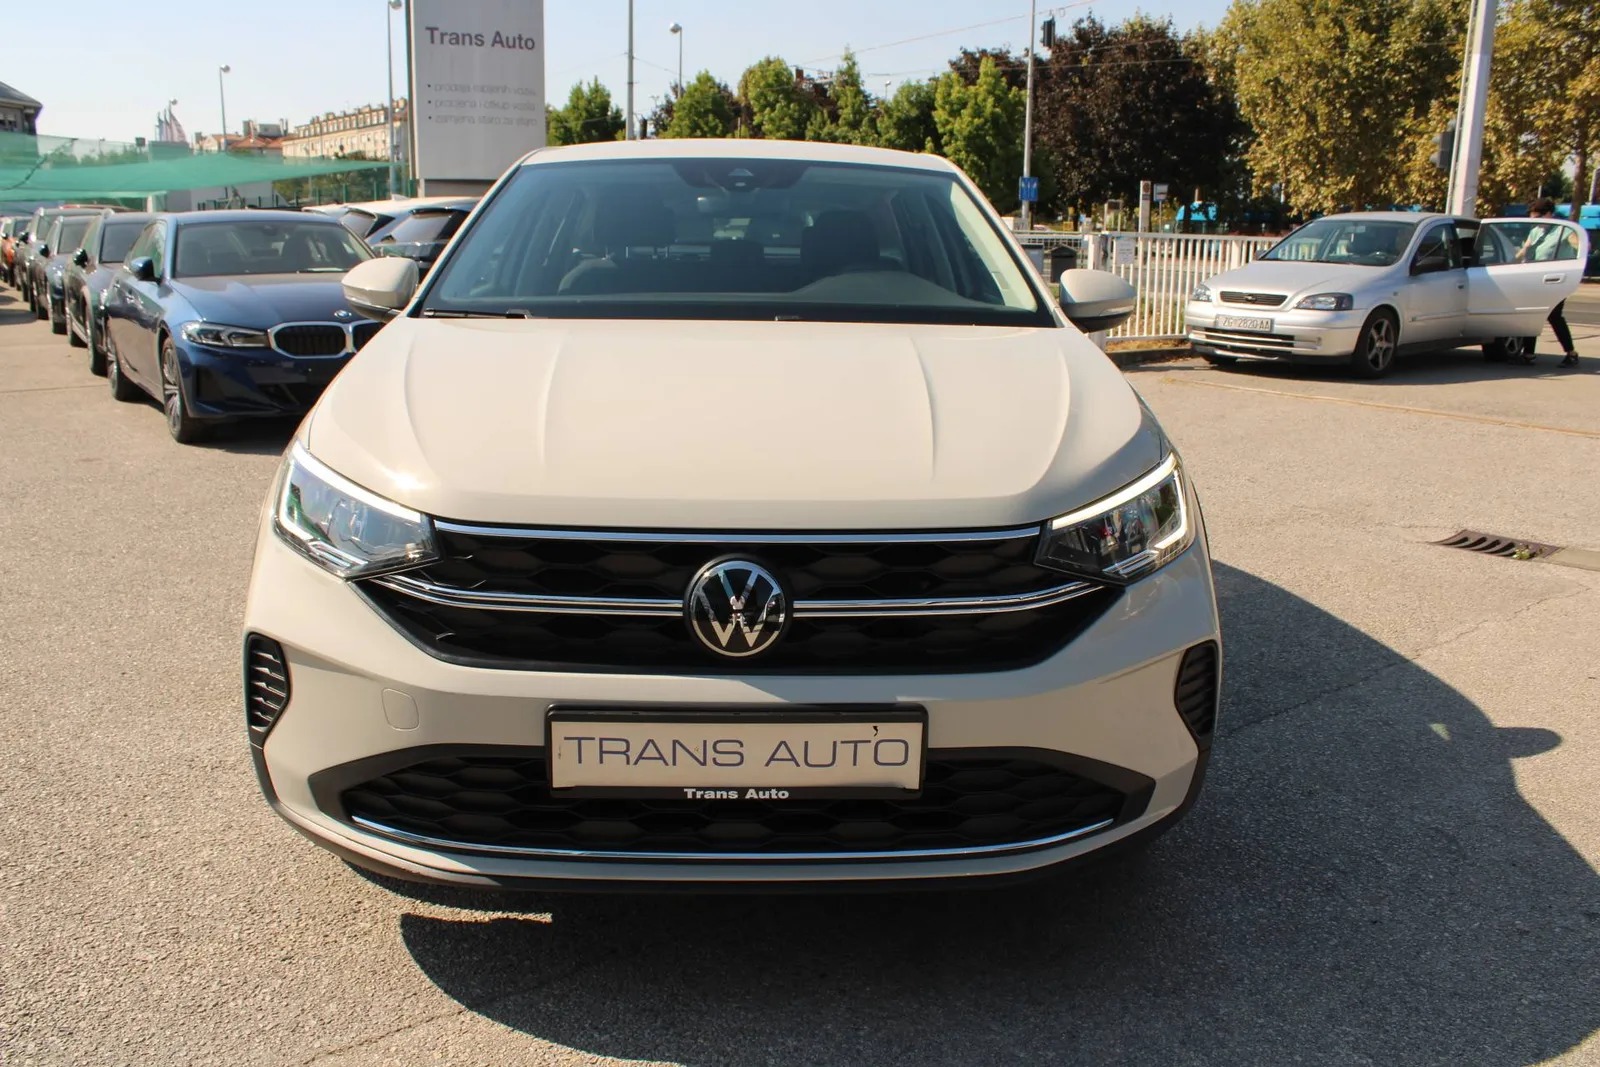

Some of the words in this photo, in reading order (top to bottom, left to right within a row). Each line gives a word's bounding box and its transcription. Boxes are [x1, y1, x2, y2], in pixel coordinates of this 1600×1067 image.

[425, 26, 485, 47] Trans
[491, 30, 536, 51] Auto
[1223, 317, 1233, 327] ZG
[563, 736, 745, 768] TRANS
[764, 738, 910, 769] AUTO
[683, 788, 738, 800] Trans
[745, 788, 790, 800] Auto
